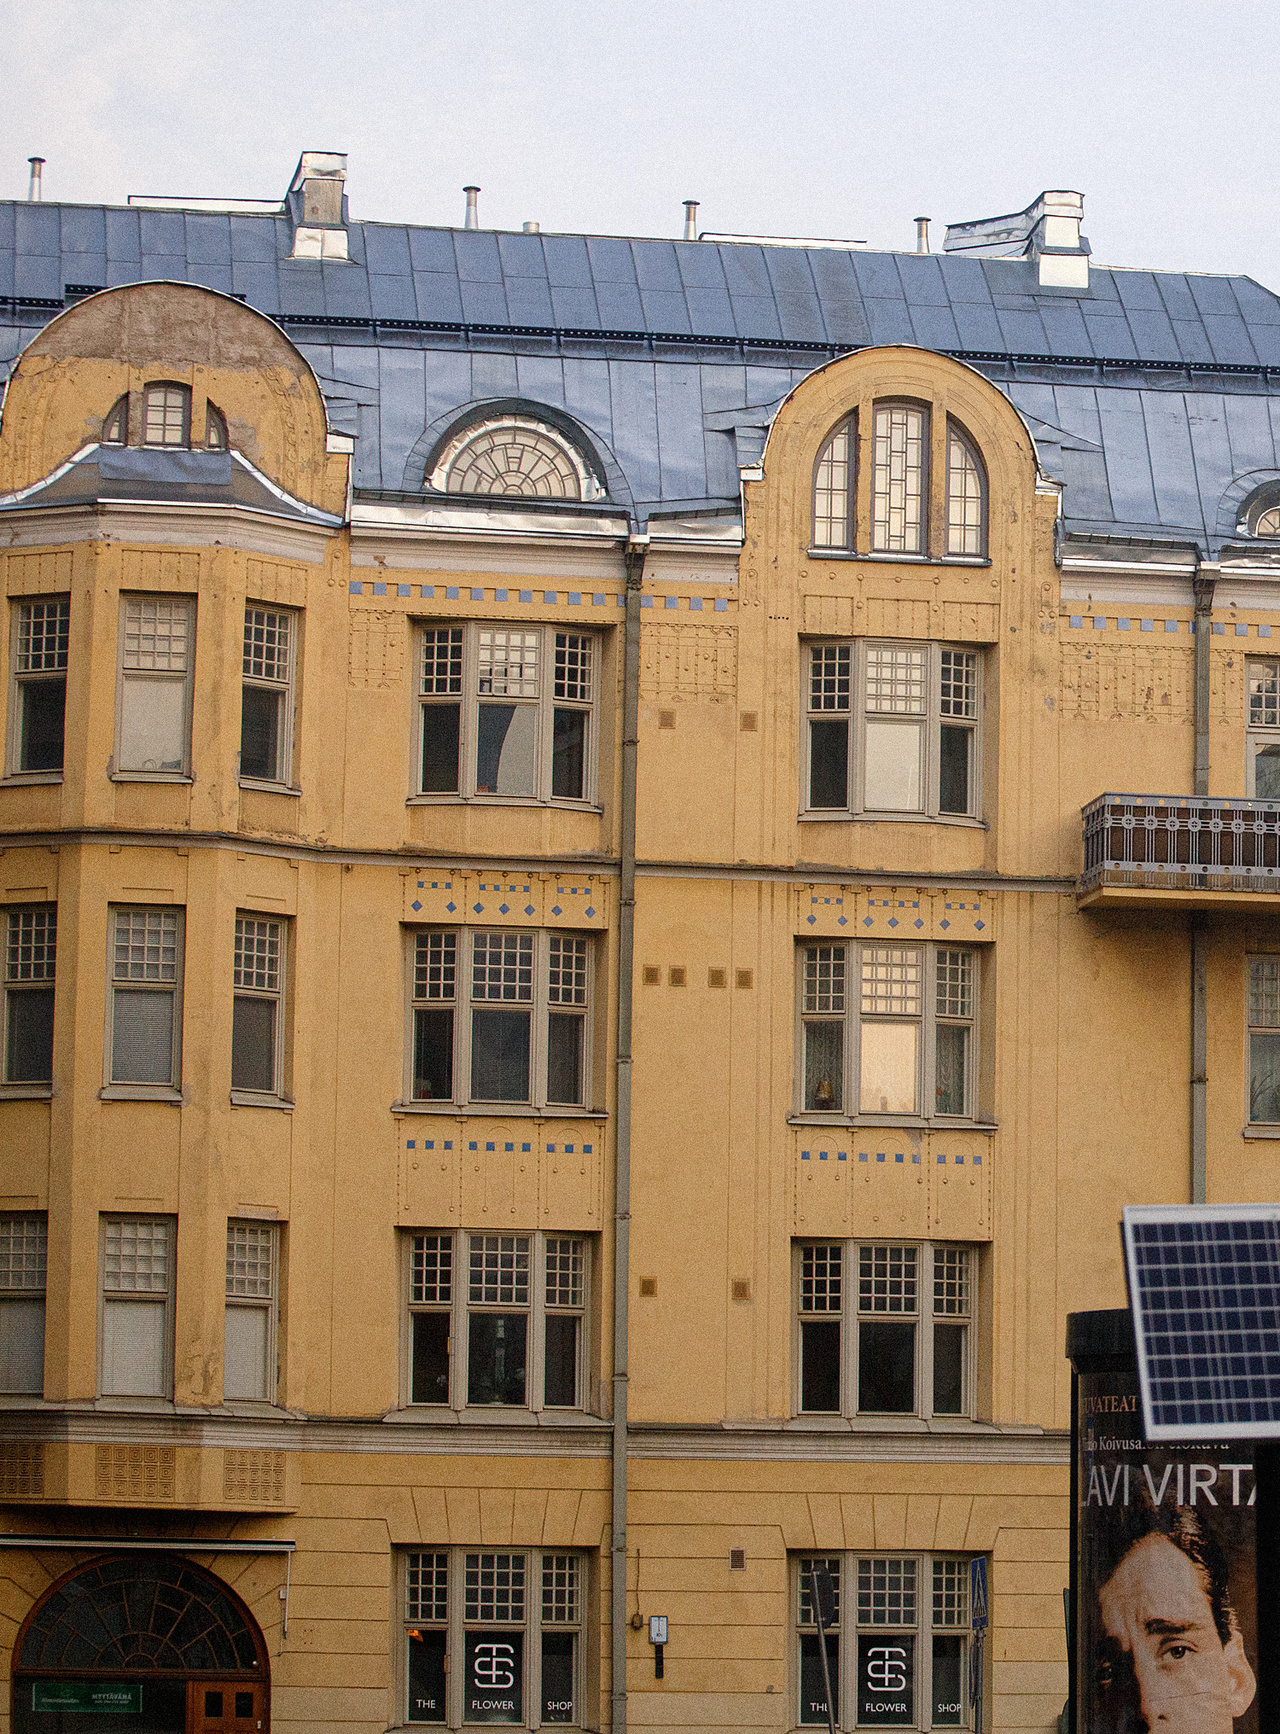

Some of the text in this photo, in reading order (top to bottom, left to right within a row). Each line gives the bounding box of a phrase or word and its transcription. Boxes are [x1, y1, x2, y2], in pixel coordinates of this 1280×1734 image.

[1099, 1436, 1165, 1451] Koivusa
[1142, 1464, 1257, 1507] VIRT
[416, 1699, 573, 1711] THE FLOWER SHOP
[865, 1703, 908, 1712] FLOWER
[937, 1703, 962, 1713] SHOP
